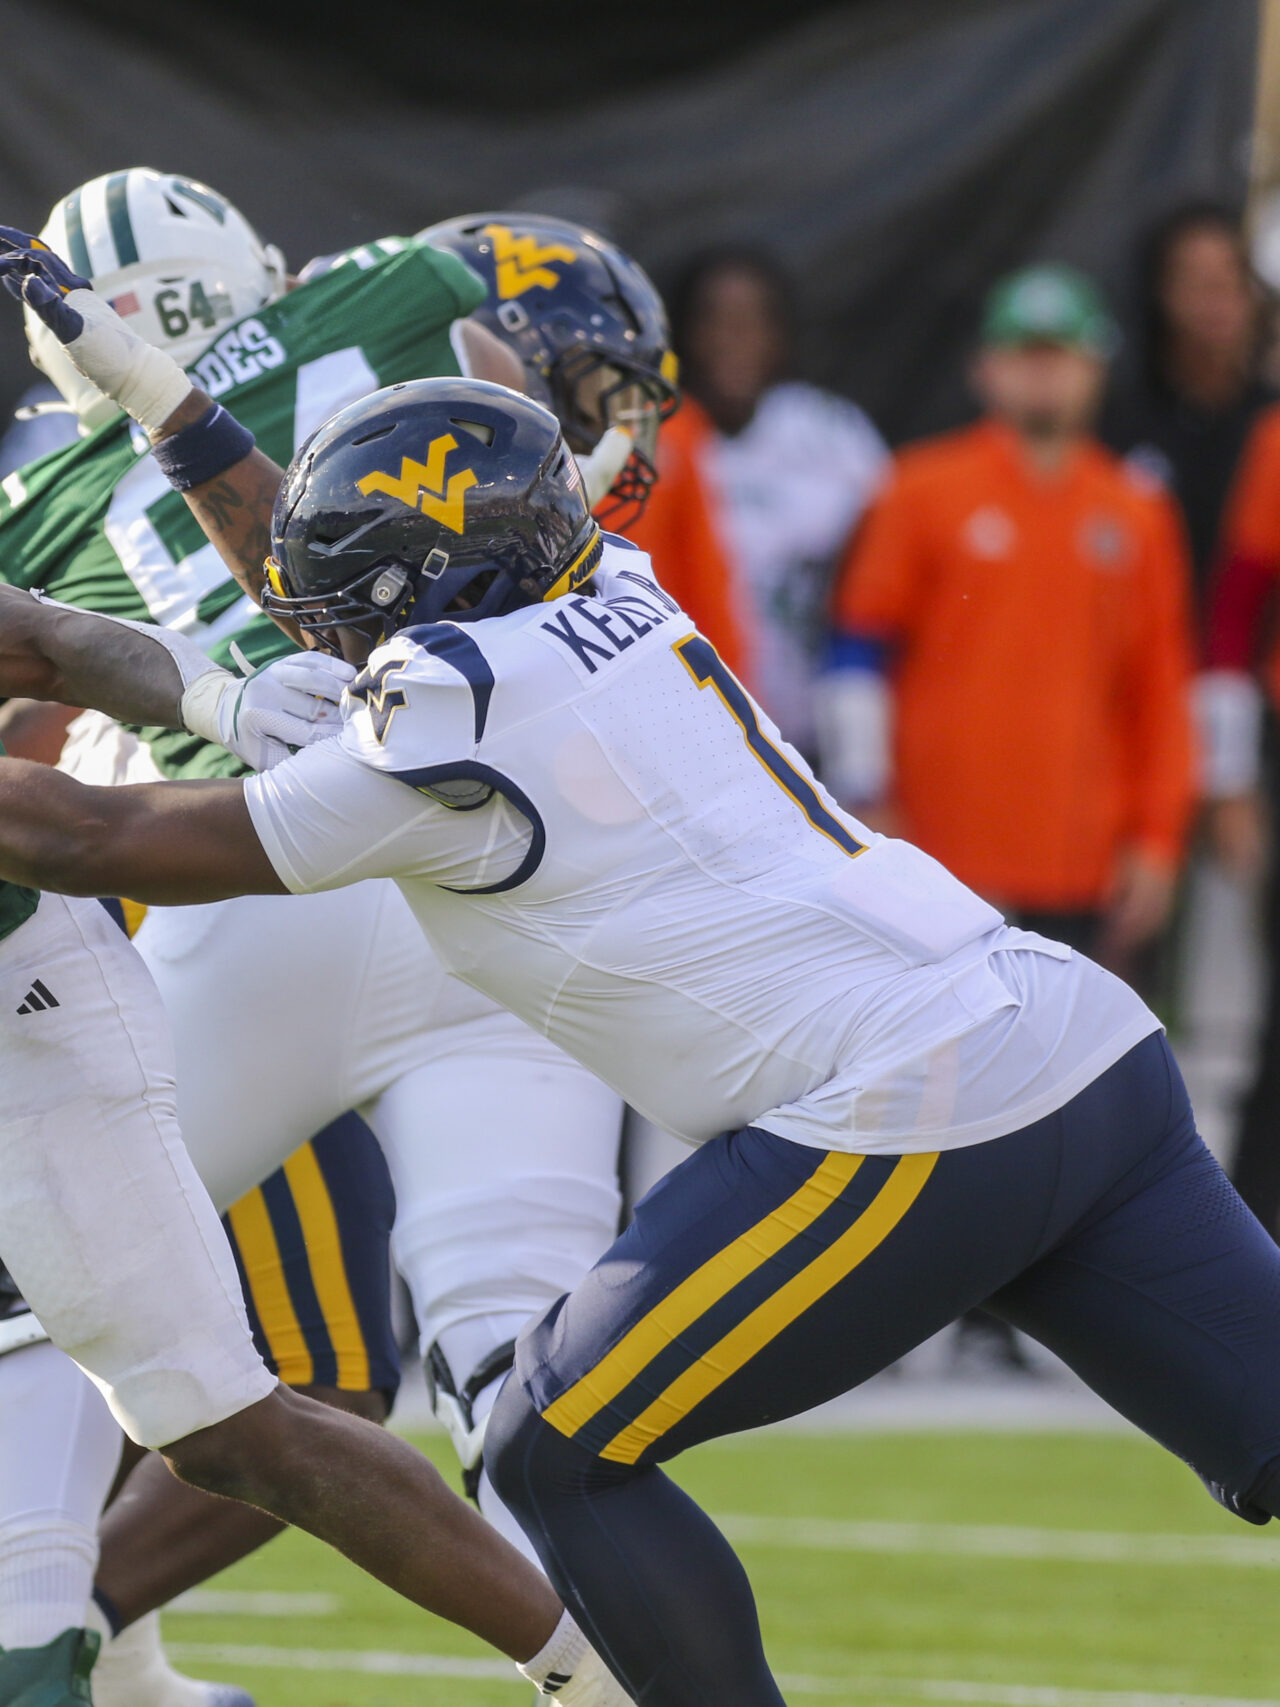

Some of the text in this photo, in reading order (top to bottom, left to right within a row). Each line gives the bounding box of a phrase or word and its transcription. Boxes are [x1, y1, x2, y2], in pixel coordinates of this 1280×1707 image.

[154, 281, 217, 338] 64
[187, 318, 286, 398] DES
[671, 632, 870, 858] 1
